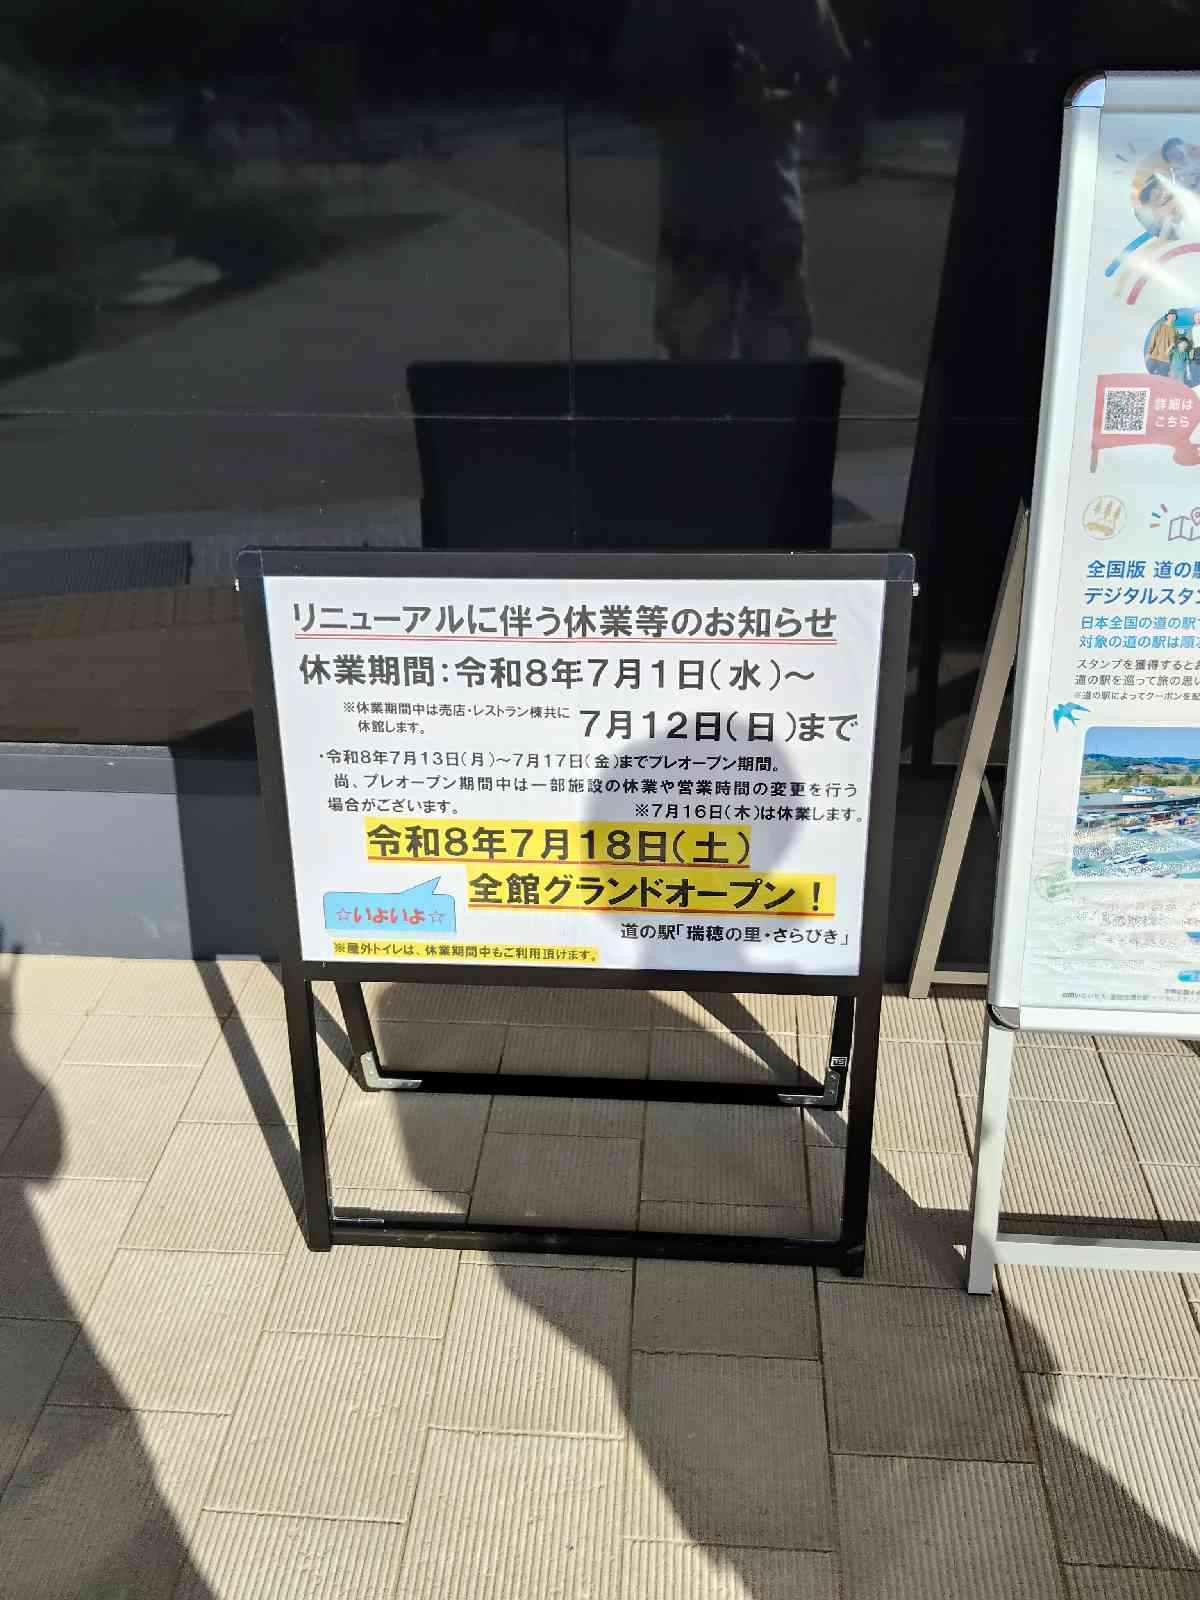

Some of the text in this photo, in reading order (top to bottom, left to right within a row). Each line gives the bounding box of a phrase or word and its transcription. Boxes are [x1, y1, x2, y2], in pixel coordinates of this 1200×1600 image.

[1155, 416, 1190, 428] こちら
[1087, 560, 1146, 579] 全国版
[1084, 587, 1200, 606] デジタルスタ
[293, 603, 837, 638] リニューアルに伴う休業等のお知らせ
[1081, 616, 1200, 631] 日本全国の道の駅
[358, 722, 426, 735] 休館します。
[328, 797, 459, 815] 場合がございます。
[621, 924, 852, 948] 道の駅「瑞穂の里・さらびき」
